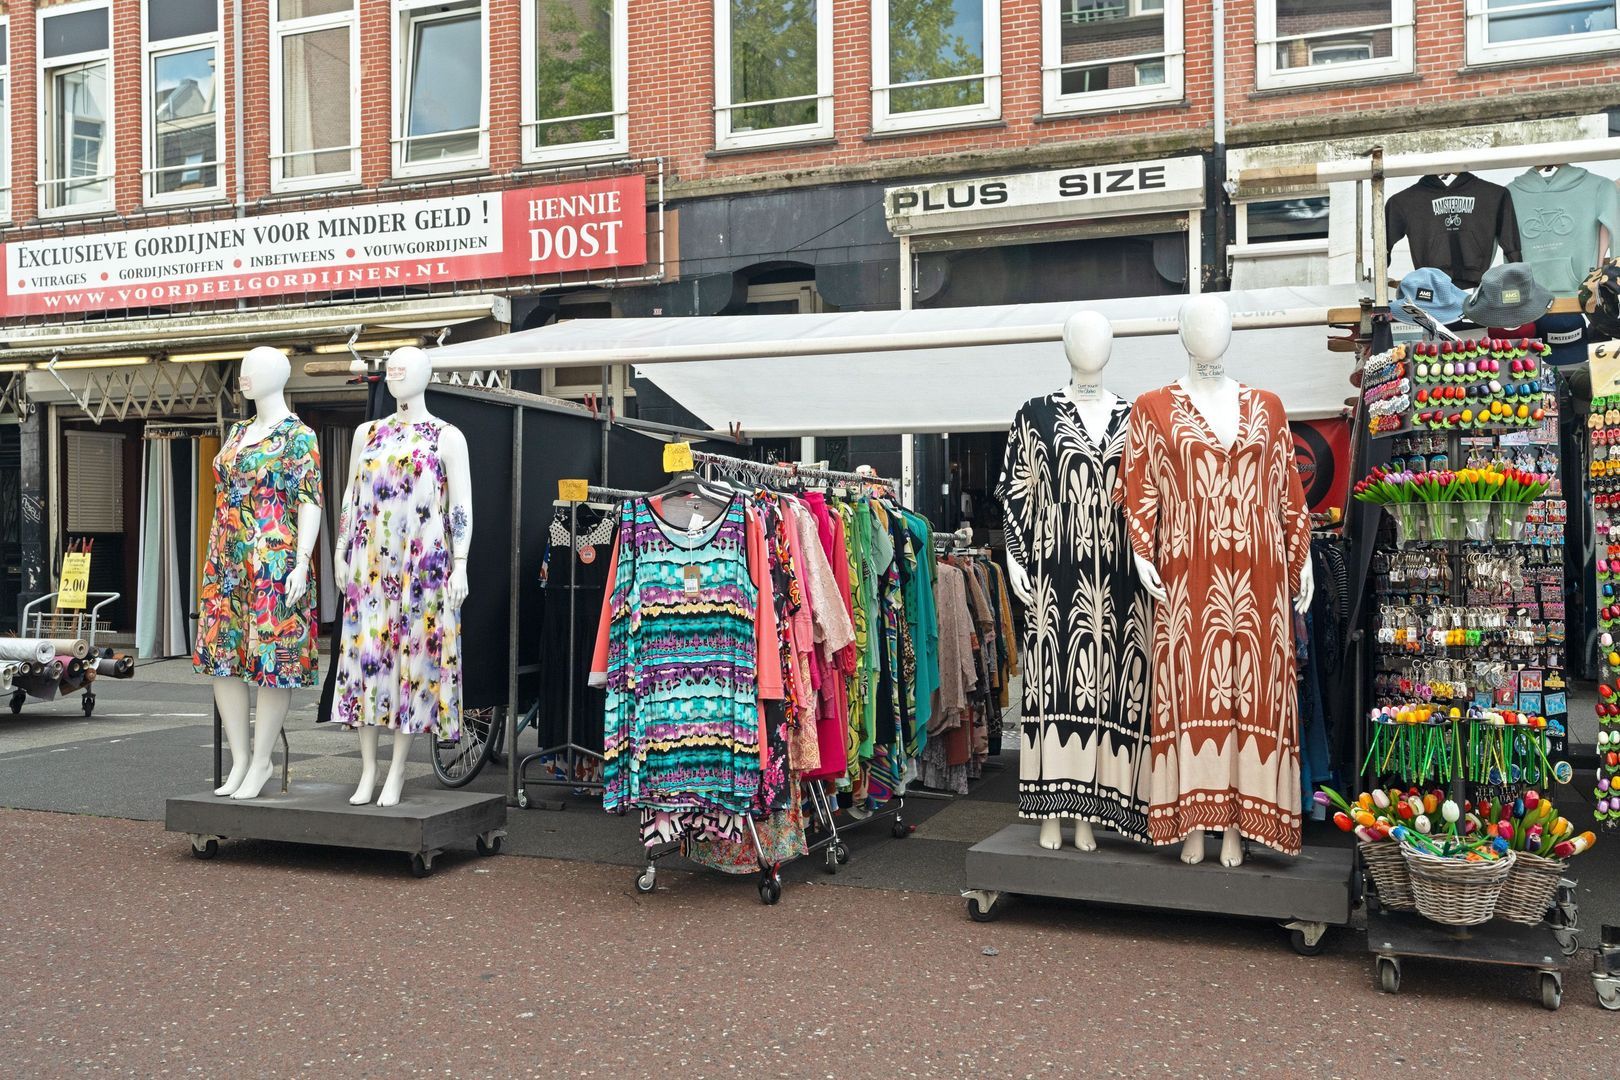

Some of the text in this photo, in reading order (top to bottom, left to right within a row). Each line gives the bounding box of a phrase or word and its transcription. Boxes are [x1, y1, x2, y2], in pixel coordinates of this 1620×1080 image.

[528, 191, 621, 222] HENNIE
[893, 166, 1166, 214] PLUS SIZE
[1432, 196, 1475, 215] AMSTERDAM
[18, 199, 489, 268] EXCLUSIEVE GORDIJNEN VOOR MINDER GELD !
[528, 220, 623, 262] DOST
[31, 236, 488, 288] VITRAGES GORDIJNSTOFFEN INBETWEENS VOUWGORDIJNEN
[44, 262, 449, 307] WWW.VOORDEELGORDIJNEN.NL
[62, 578, 86, 592] 2.00
